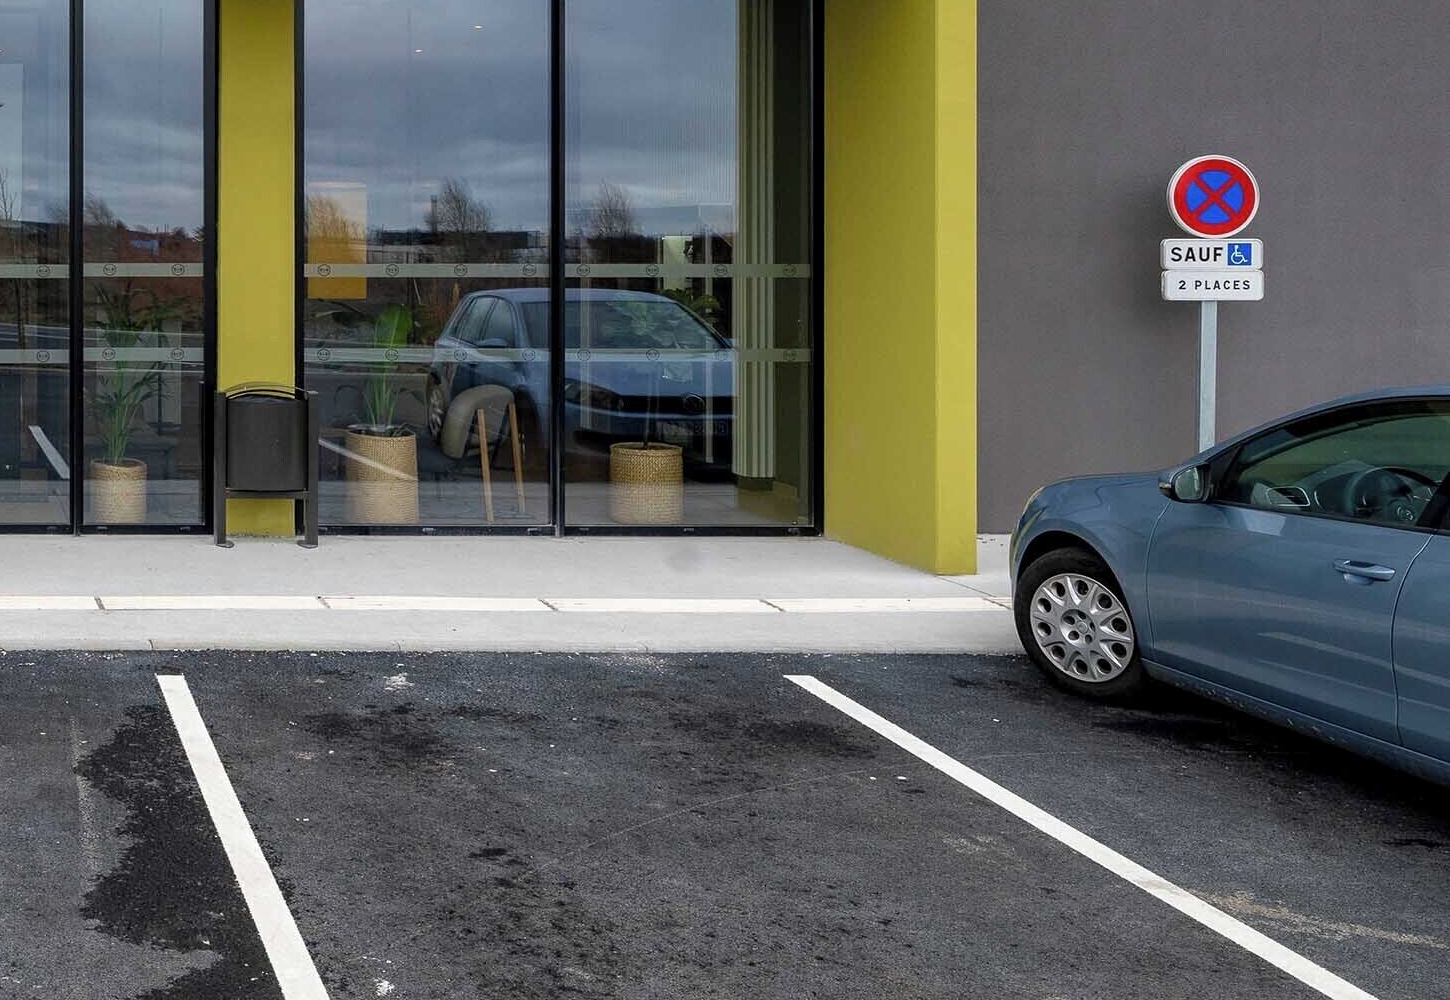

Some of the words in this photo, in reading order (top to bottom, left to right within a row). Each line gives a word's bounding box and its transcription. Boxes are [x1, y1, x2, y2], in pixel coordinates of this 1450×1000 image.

[1171, 247, 1223, 262] SAUF
[1179, 280, 1187, 290] 2
[1195, 280, 1250, 290] PLACES
